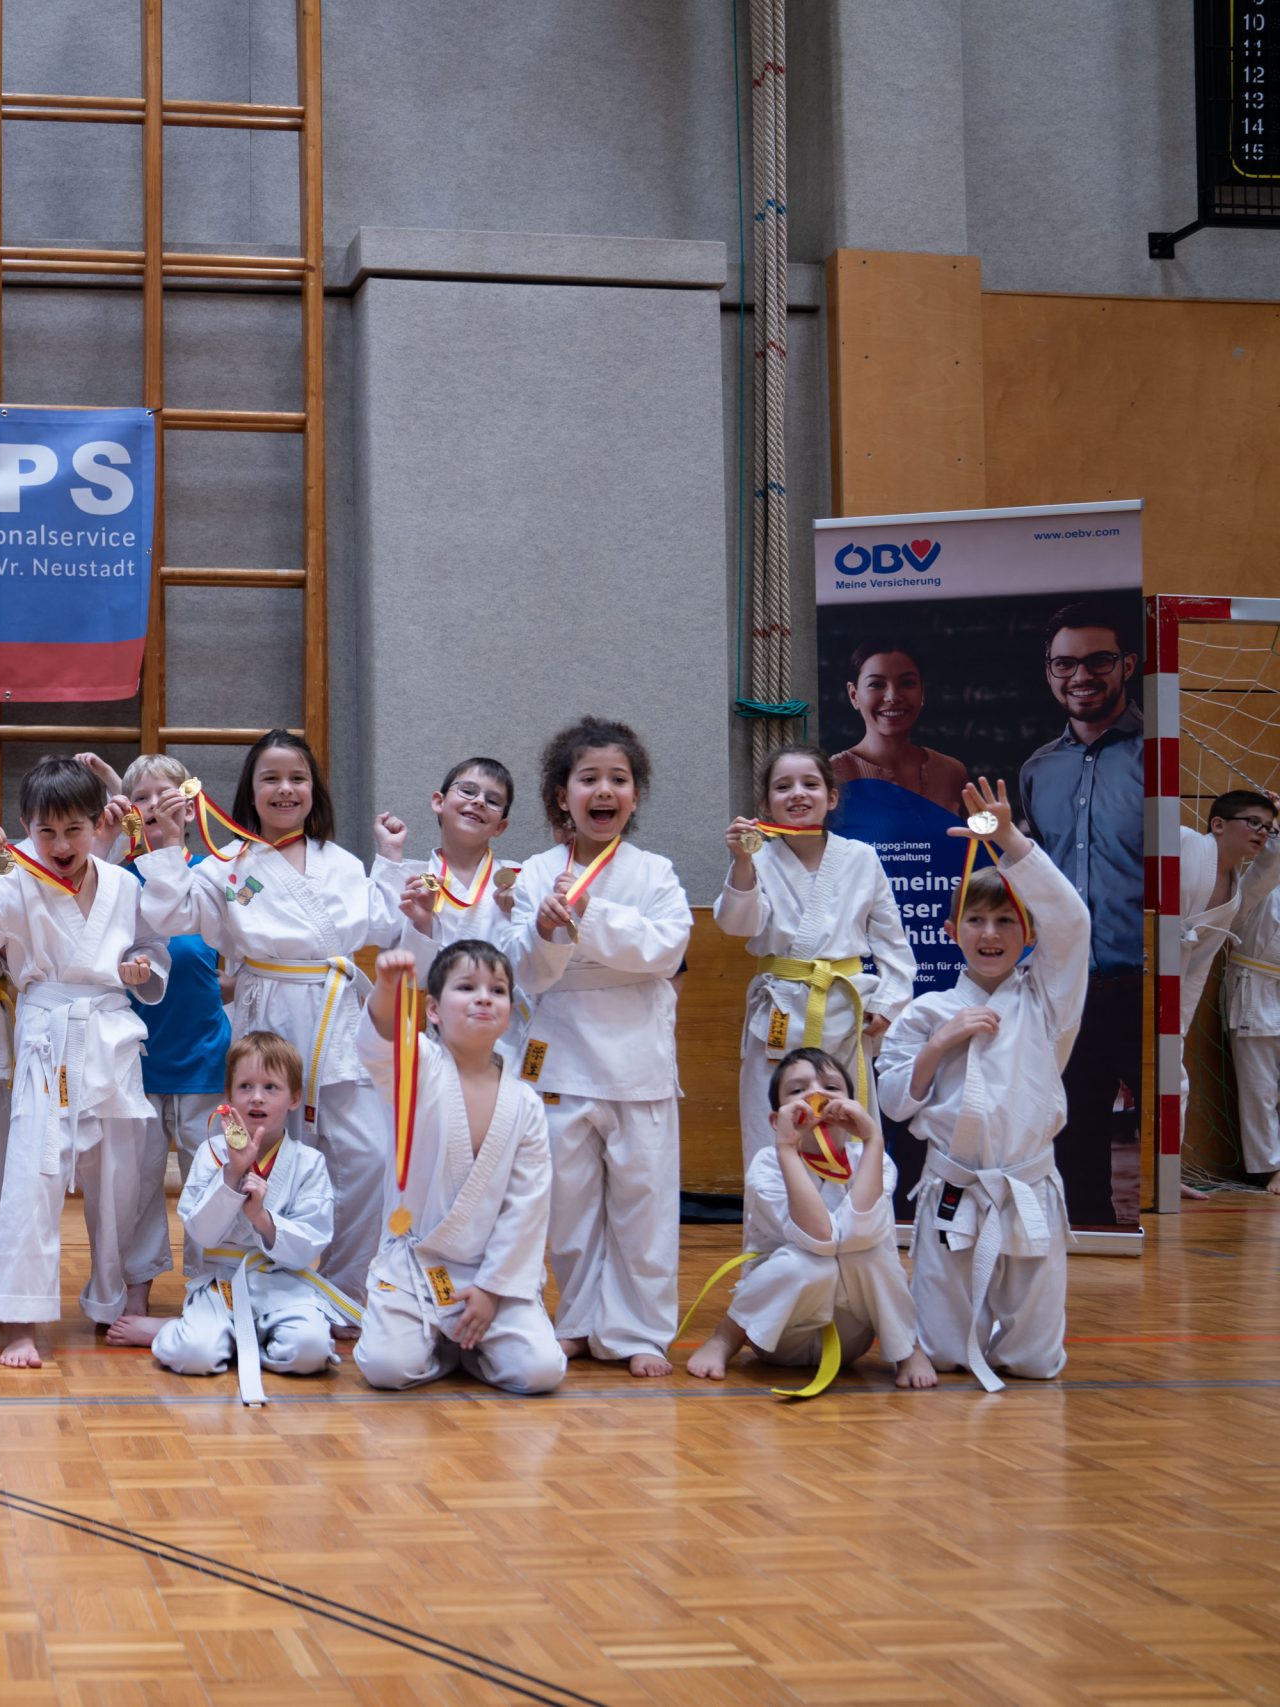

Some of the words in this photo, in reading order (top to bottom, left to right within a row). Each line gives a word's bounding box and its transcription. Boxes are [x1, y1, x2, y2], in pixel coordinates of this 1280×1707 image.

[1243, 13, 1265, 31] 10
[1243, 40, 1261, 57] 11
[1243, 66, 1265, 83] 12
[1243, 91, 1265, 109] 13
[1242, 117, 1265, 135] 14
[1242, 143, 1264, 160] 15
[1034, 528, 1120, 541] www.oebv.com
[32, 557, 135, 578] Neustadt
[835, 581, 867, 590] Meine
[870, 577, 942, 588] Versicherung
[887, 871, 963, 891] meins
[937, 961, 951, 971] für
